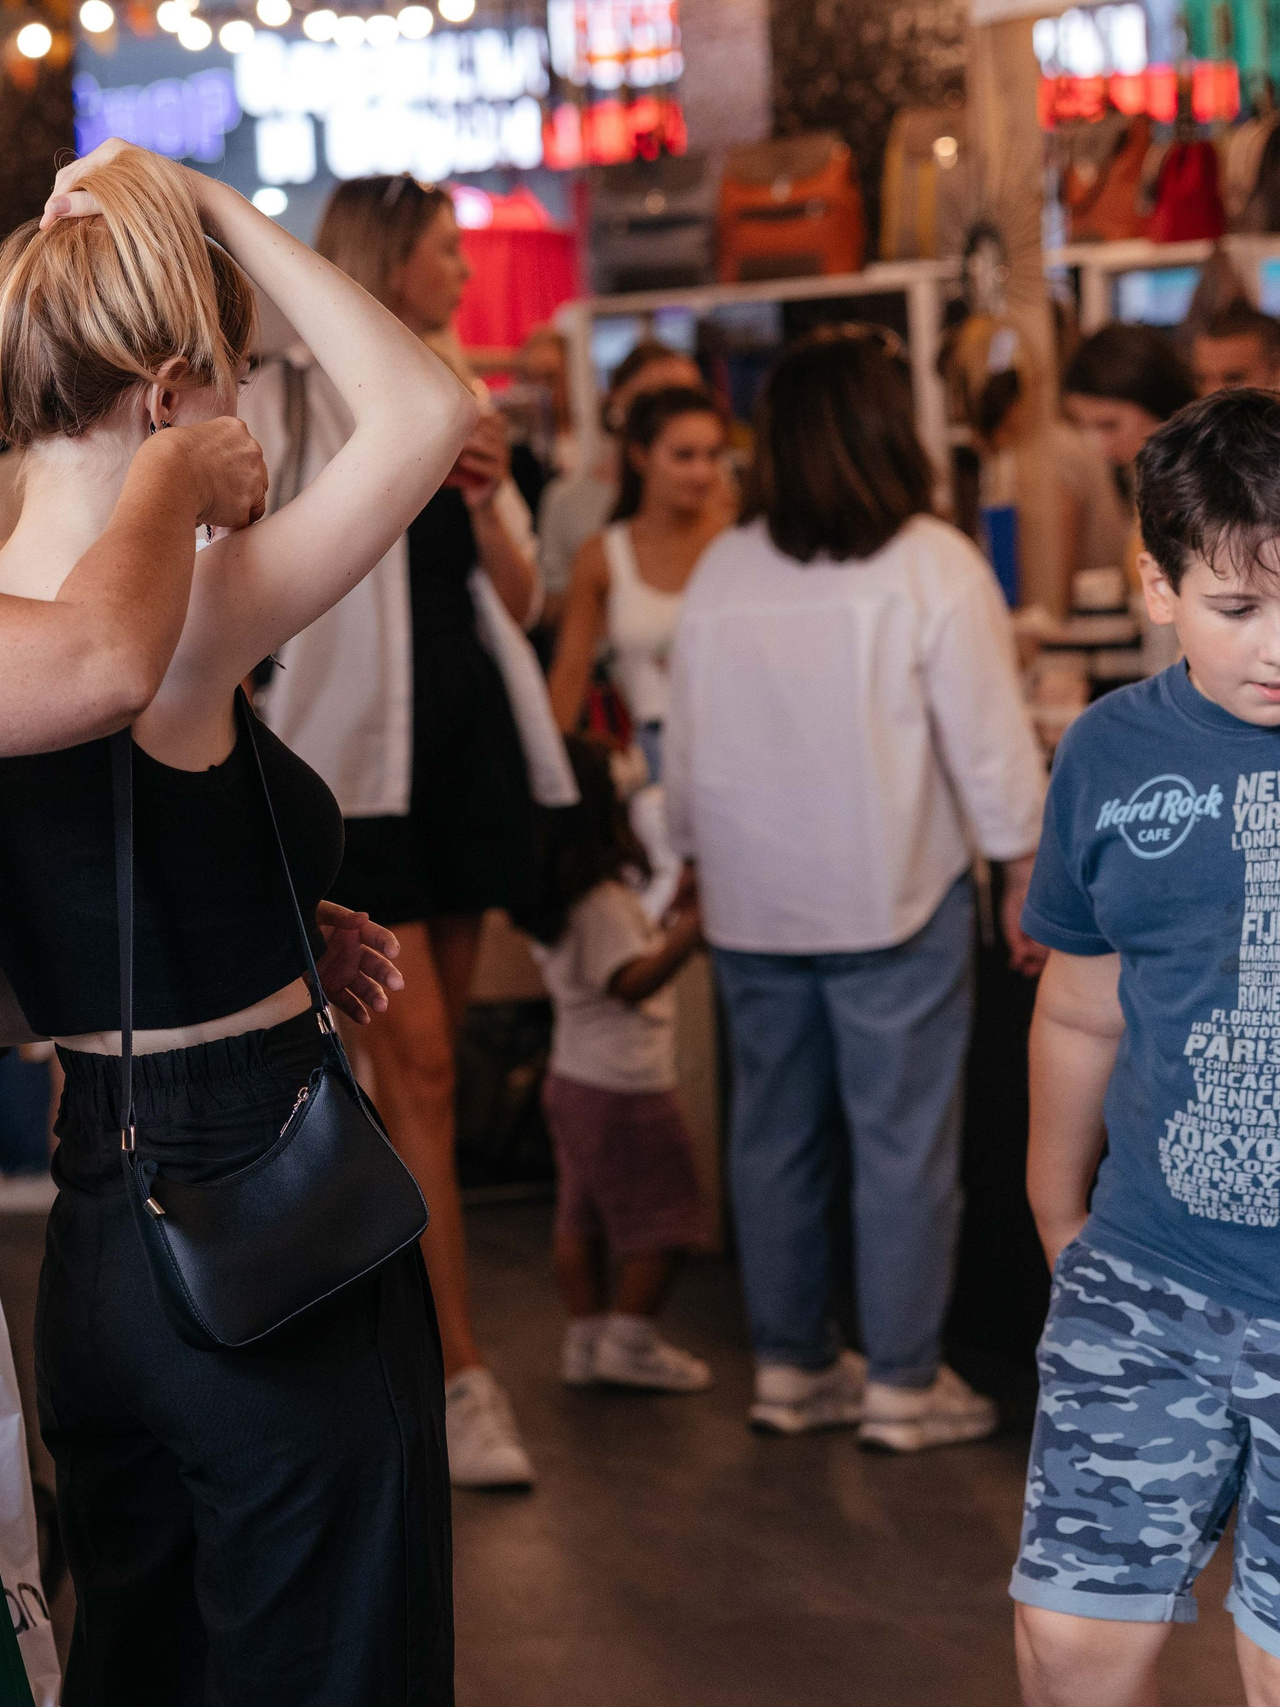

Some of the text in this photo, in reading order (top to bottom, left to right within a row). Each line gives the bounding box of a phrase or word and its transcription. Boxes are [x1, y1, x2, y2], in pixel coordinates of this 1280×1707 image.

[1234, 770, 1280, 804] NE
[1095, 783, 1224, 831] Hard Rock
[1137, 827, 1171, 843] CAFE
[1244, 895, 1280, 912] PANAM
[1237, 985, 1280, 1011] ROME
[1183, 1033, 1280, 1064] PARIS
[1158, 1136, 1280, 1176] BANGKOK
[1164, 1118, 1280, 1163] TOKYO
[1188, 1204, 1280, 1228] MOSCOW
